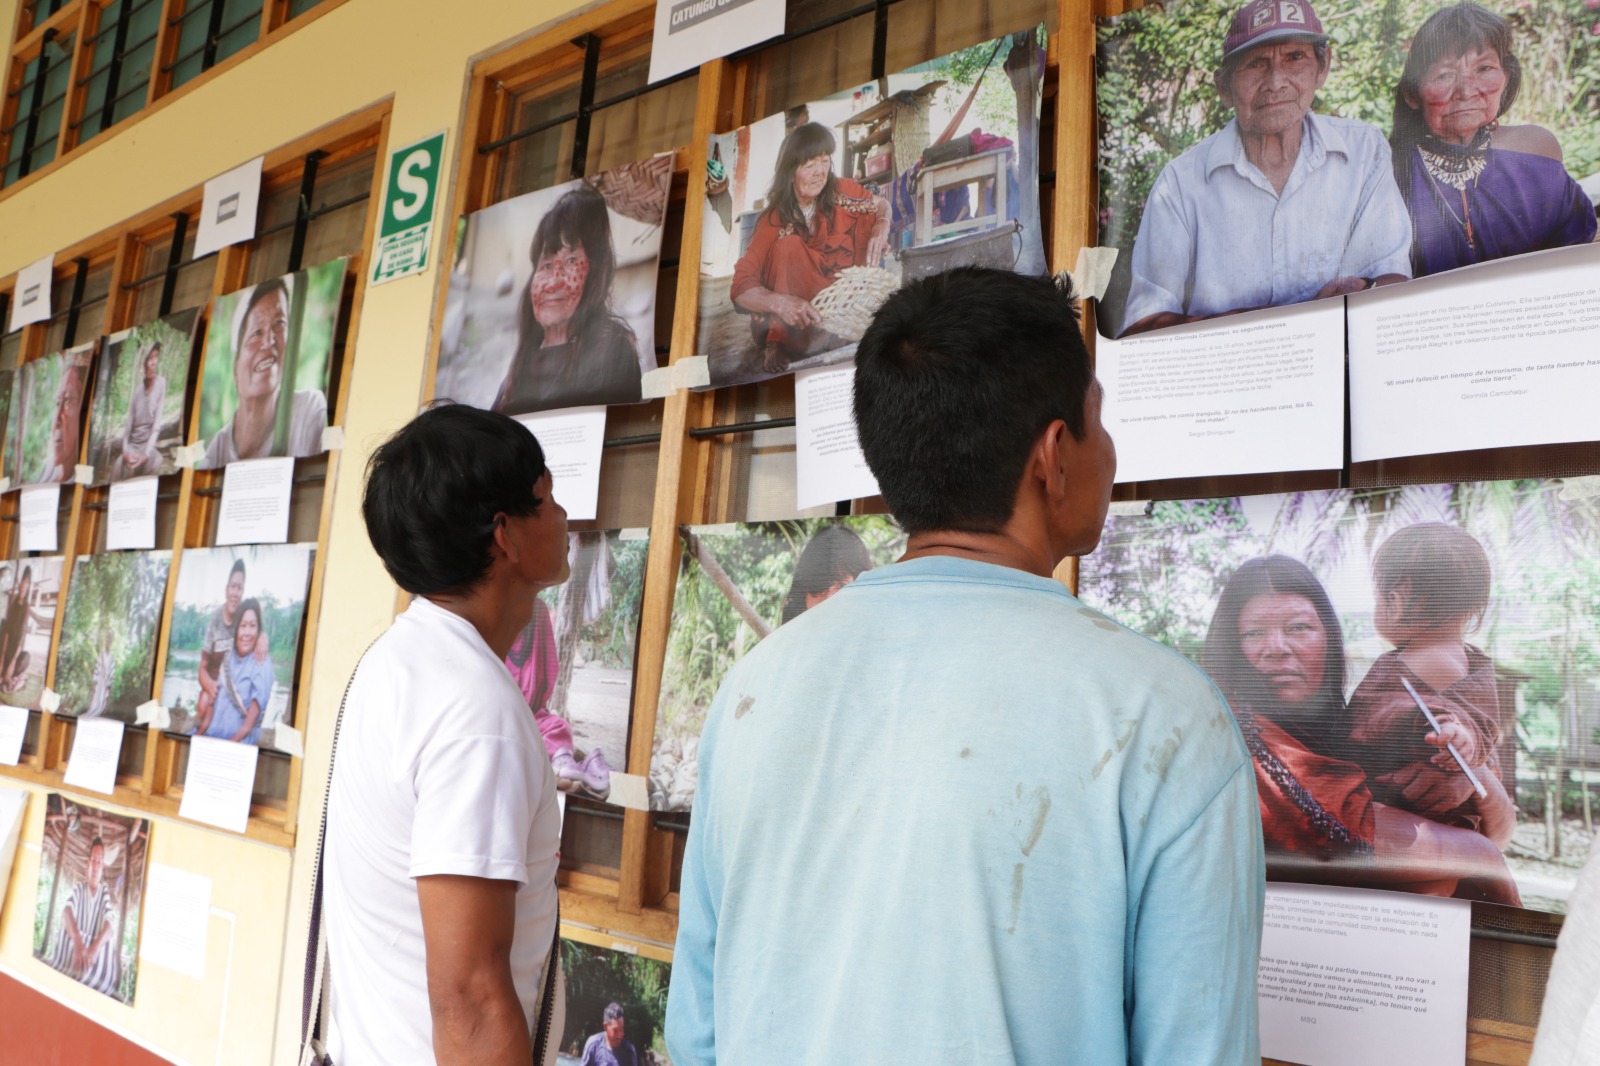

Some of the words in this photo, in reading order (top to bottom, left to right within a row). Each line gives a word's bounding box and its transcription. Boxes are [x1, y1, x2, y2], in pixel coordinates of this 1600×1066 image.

[1286, 4, 1300, 21] 2
[392, 149, 432, 221] S
[1300, 1016, 1317, 1024] MSQ
